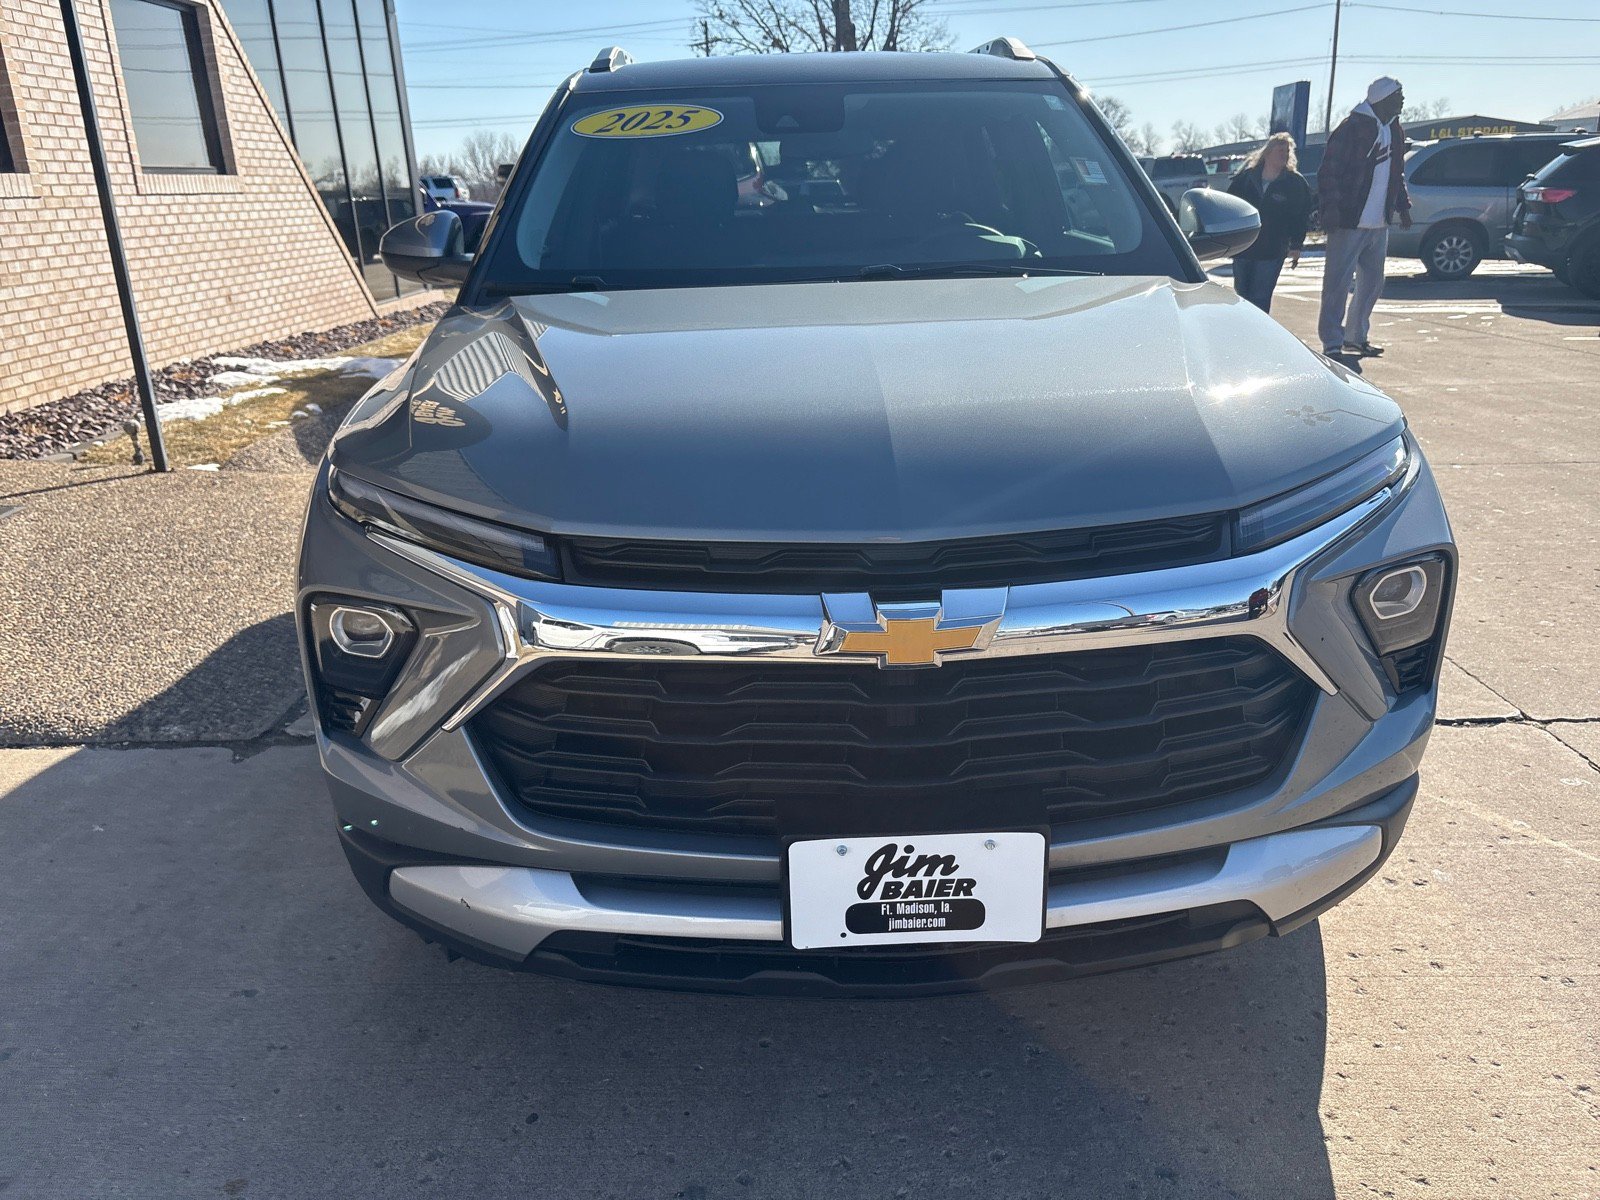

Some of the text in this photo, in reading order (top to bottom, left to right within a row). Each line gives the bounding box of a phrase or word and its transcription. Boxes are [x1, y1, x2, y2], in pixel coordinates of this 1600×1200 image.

[593, 110, 700, 134] 2025
[858, 843, 959, 900] Jim
[880, 878, 977, 900] BAIER
[882, 905, 893, 915] Ft.
[897, 903, 938, 914] Madison,
[888, 917, 946, 931] jimbaier.com
